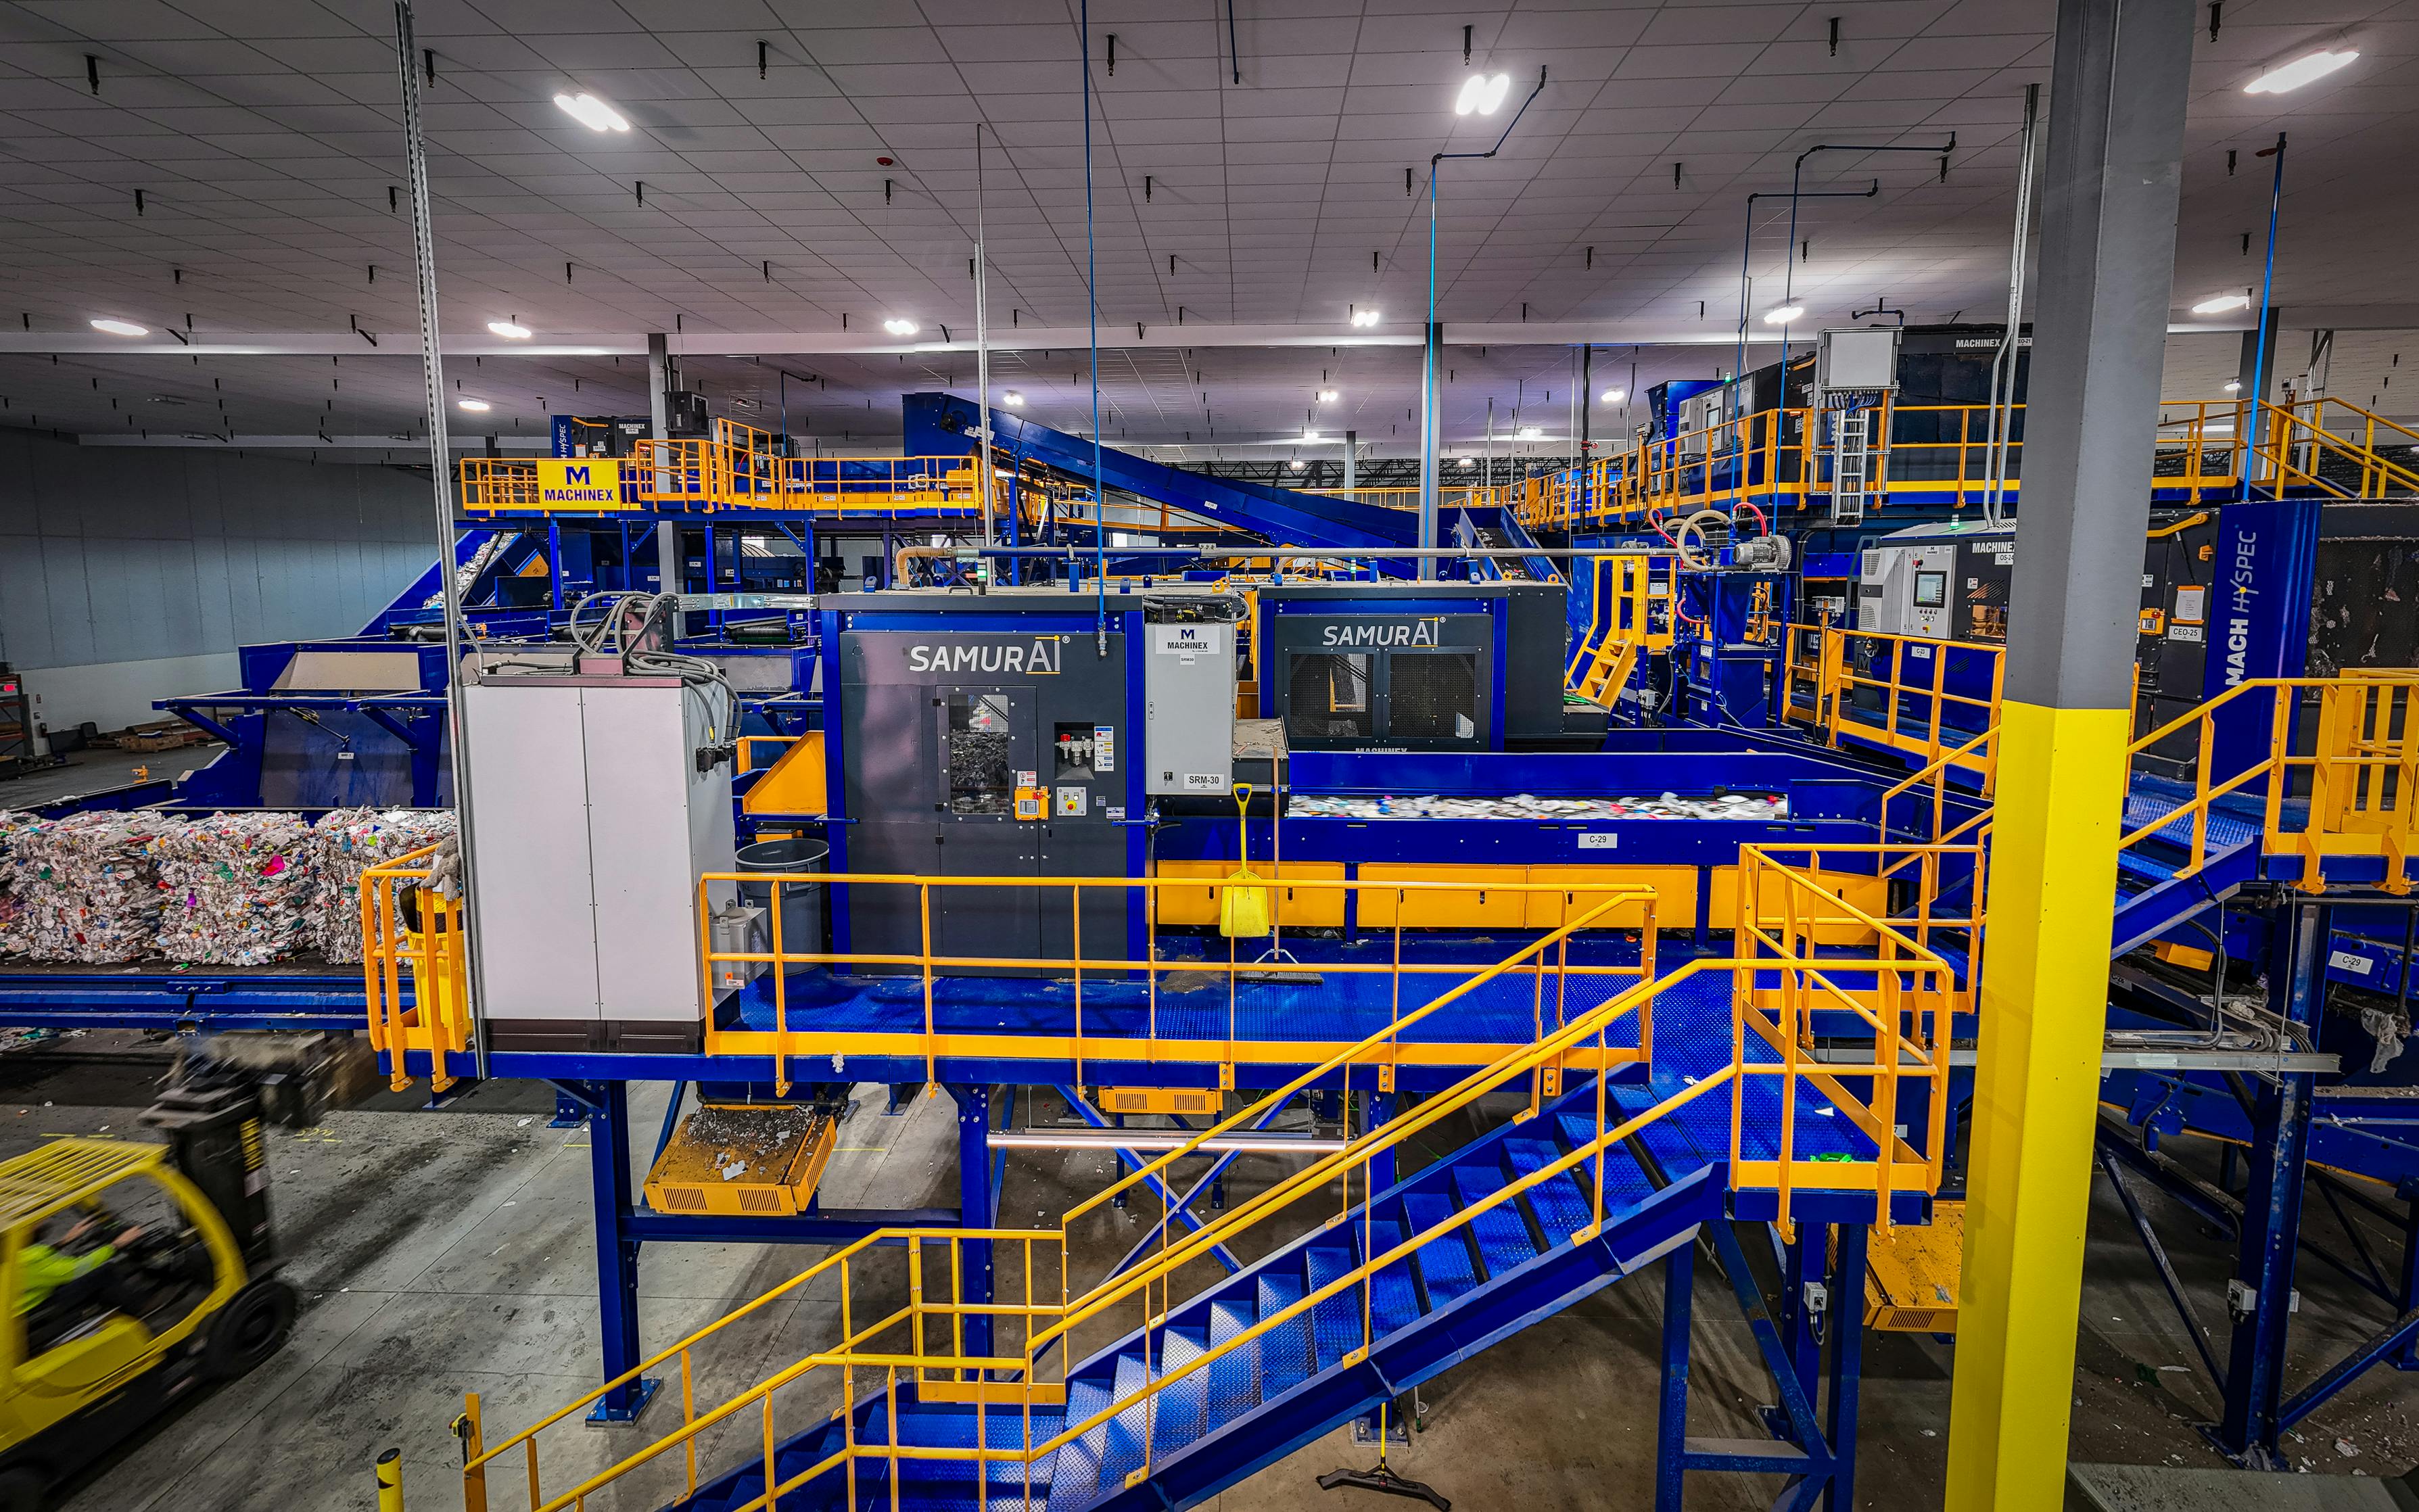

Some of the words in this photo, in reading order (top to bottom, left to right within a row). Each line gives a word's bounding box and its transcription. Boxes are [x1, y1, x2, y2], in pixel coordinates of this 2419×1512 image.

[1956, 339, 2000, 348] MACHINEX
[559, 424, 569, 453] HYSPEC
[565, 466, 592, 486] M
[544, 489, 614, 501] MACHINEX
[2230, 530, 2259, 613] HYSPEC
[1181, 629, 1195, 640] M
[2173, 628, 2198, 636] CEO-25
[2225, 619, 2249, 686] MACH
[1189, 776, 1219, 784] SRM-30
[1589, 835, 1607, 843] C-29
[2342, 955, 2361, 966] C-29
